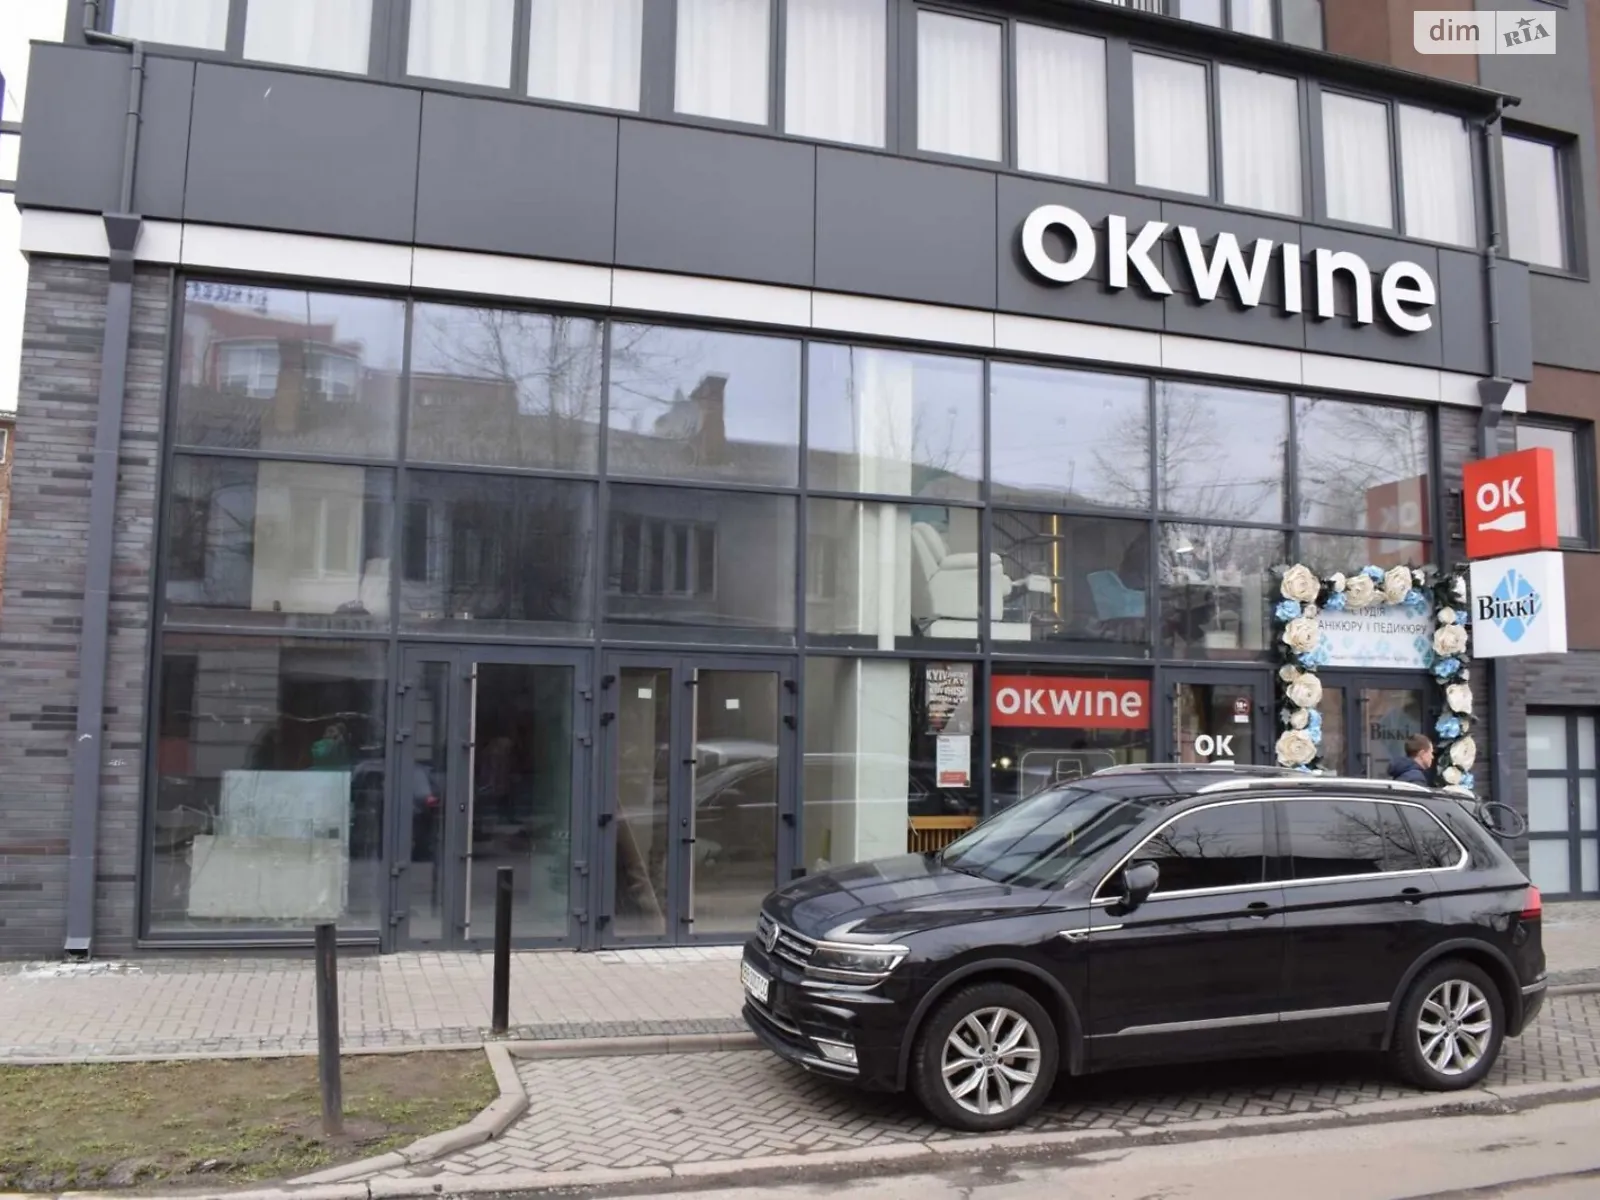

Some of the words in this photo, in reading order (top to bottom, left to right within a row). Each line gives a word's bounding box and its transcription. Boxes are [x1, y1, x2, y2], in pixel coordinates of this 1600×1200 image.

[1476, 476, 1525, 512] OK
[1476, 592, 1536, 621] Віккі
[1318, 619, 1363, 633] АНІКЮРУ
[1194, 734, 1235, 756] OK
